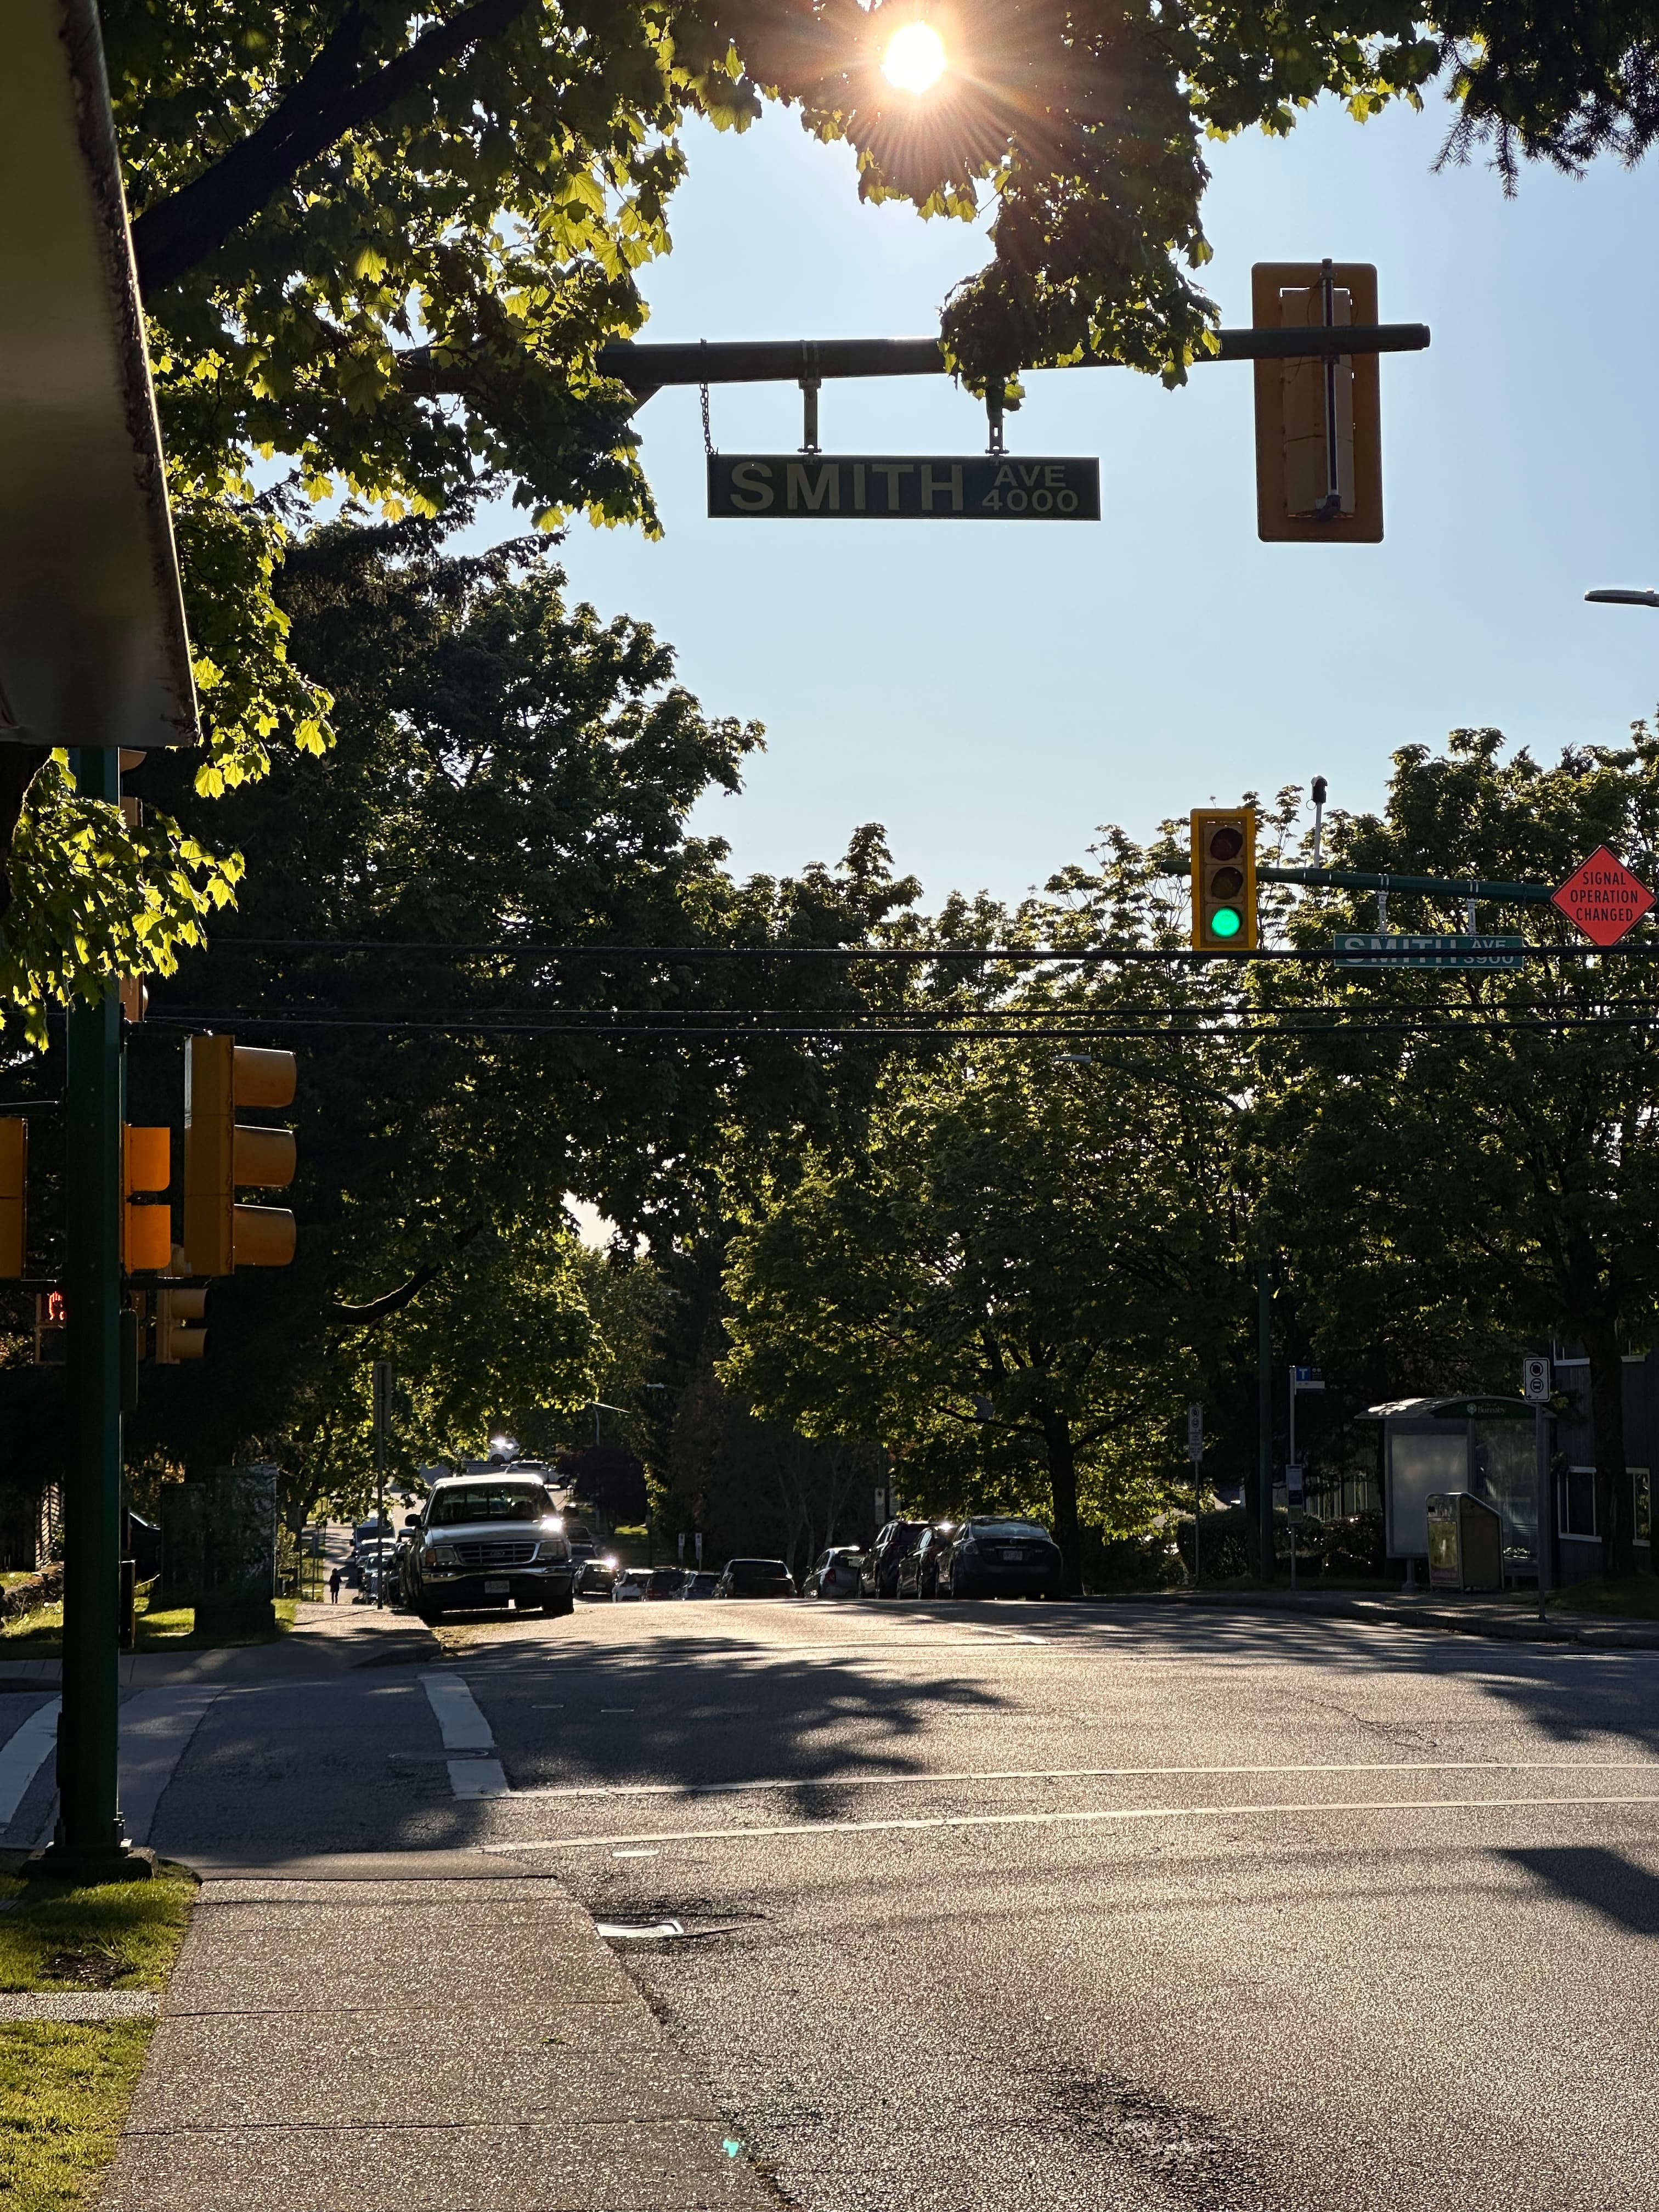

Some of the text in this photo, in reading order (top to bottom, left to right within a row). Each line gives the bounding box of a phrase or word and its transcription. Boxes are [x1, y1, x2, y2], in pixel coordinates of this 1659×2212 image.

[994, 465, 1066, 487] AVE
[730, 461, 963, 511] SMITH
[982, 489, 1079, 512] 4000
[1583, 872, 1626, 885] SIGNAL
[1570, 890, 1638, 904] OPERATION
[1576, 907, 1633, 921] CHANGED
[1344, 938, 1458, 964] SMITH
[1463, 955, 1515, 964] 3900
[1479, 1406, 1505, 1415] Burnaby
